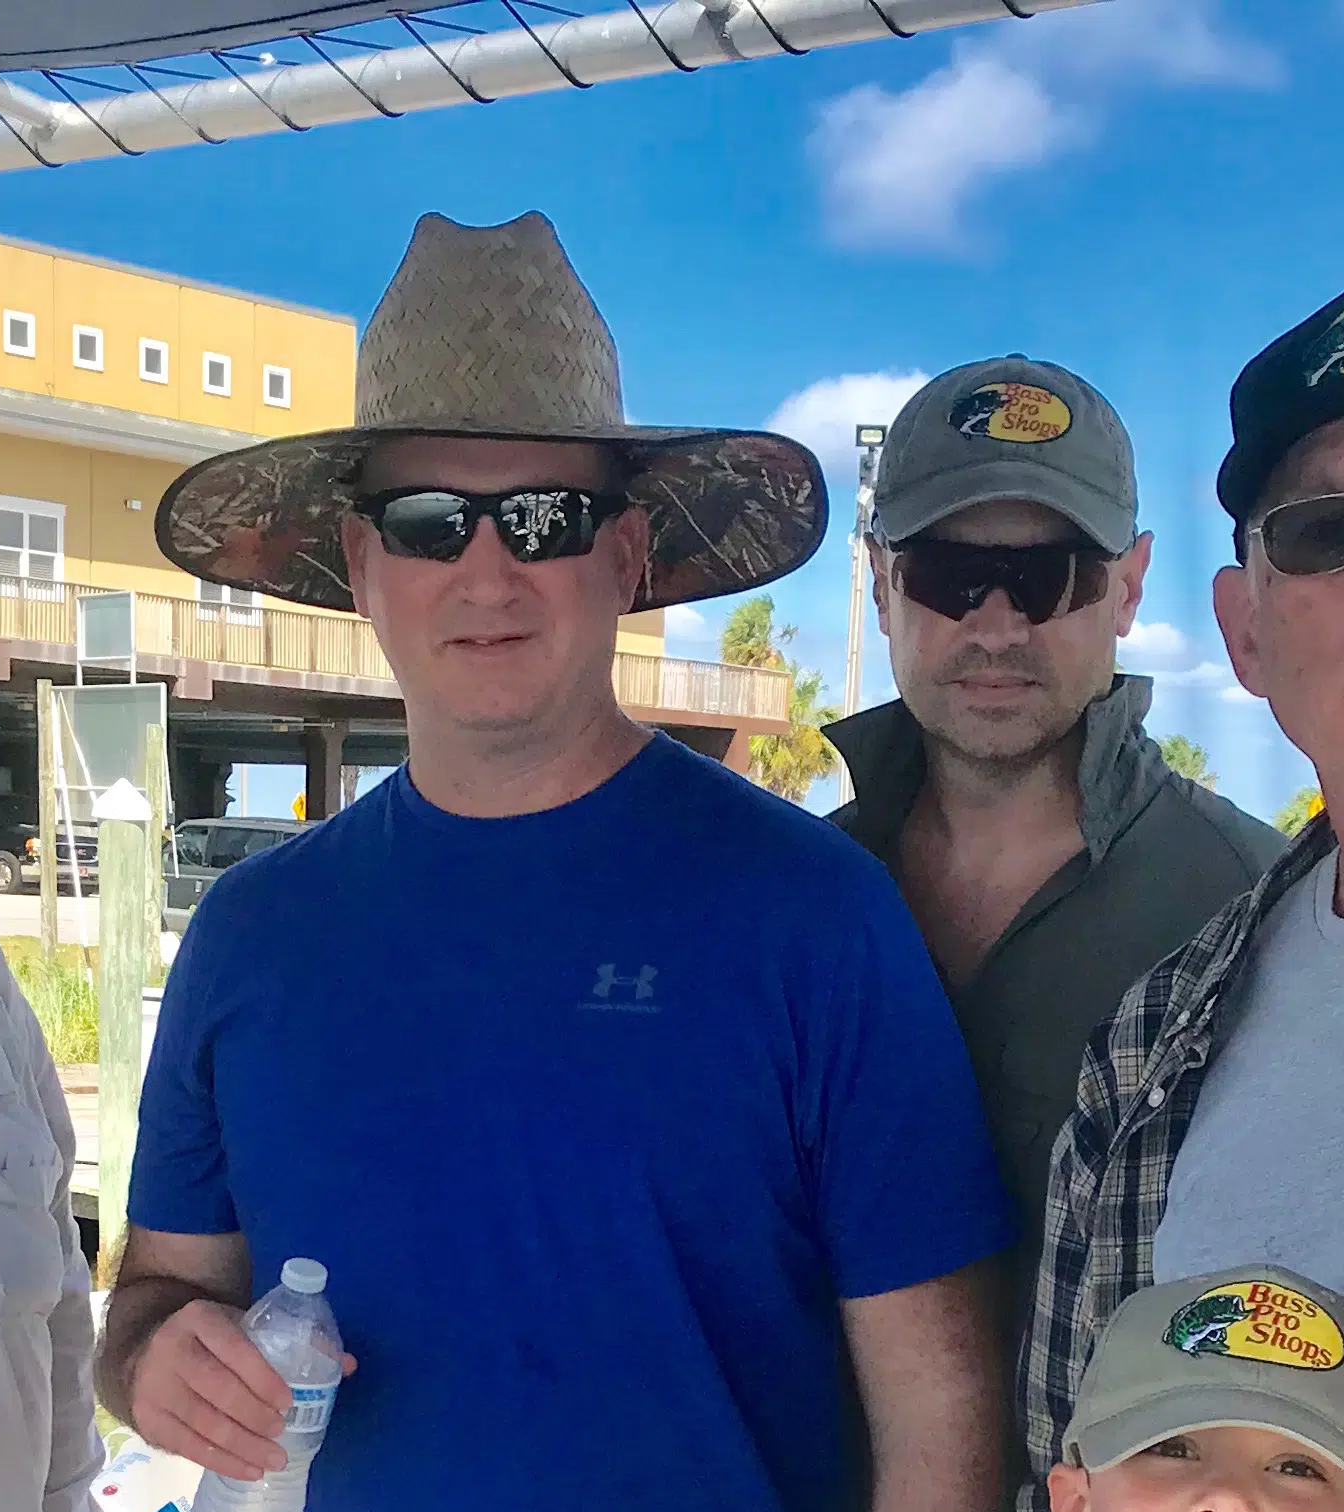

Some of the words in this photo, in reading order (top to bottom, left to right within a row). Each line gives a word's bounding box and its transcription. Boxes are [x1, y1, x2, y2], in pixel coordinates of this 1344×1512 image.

[1006, 384, 1053, 404] Bass
[1004, 398, 1040, 416] Pro
[1001, 413, 1061, 437] Shops
[1246, 1284, 1318, 1318] Bass
[1250, 1304, 1301, 1331] Pro
[1245, 1322, 1333, 1367] Shops
